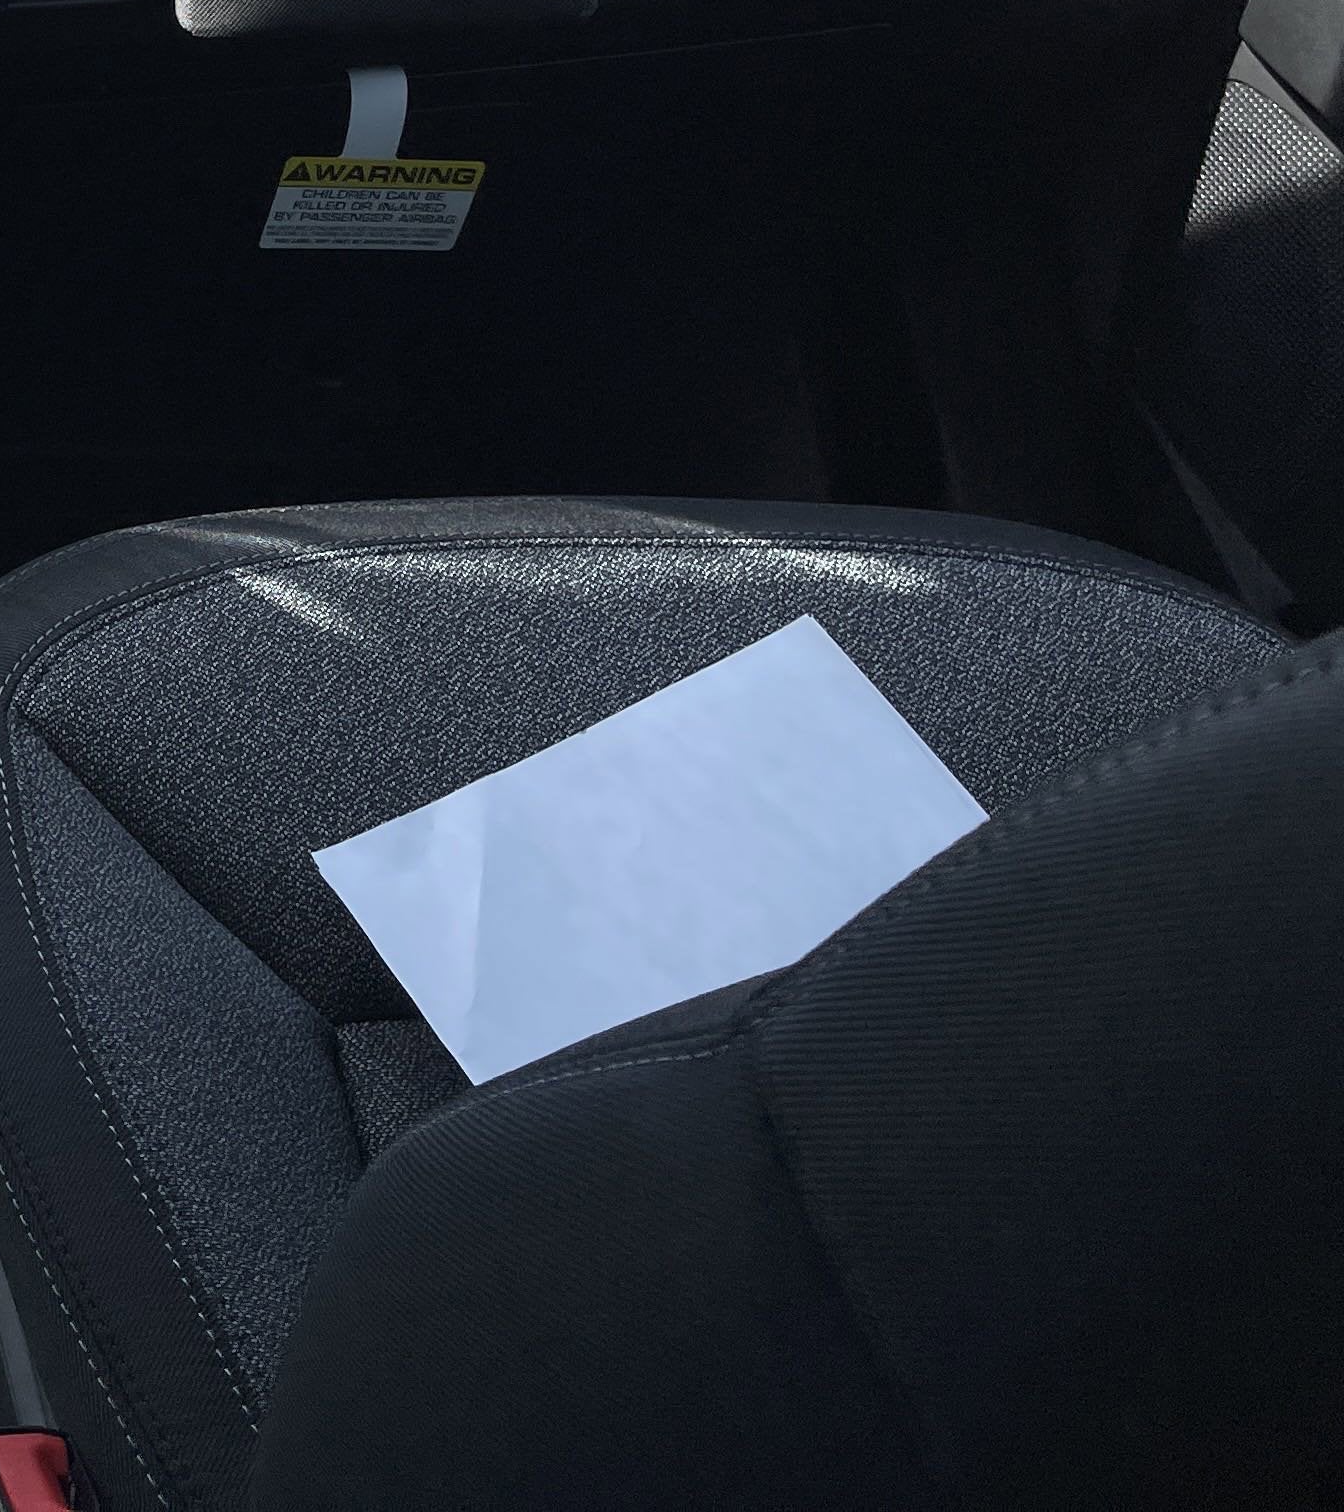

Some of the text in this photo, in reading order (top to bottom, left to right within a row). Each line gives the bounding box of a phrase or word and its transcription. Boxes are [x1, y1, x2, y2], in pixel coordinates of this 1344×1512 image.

[315, 163, 477, 185] WARNING
[301, 189, 380, 200] CHILDREN
[385, 190, 419, 201] CAN
[292, 200, 447, 213] KILLED OR INJURED
[273, 210, 293, 222] BY
[299, 211, 393, 223] PASSENGER
